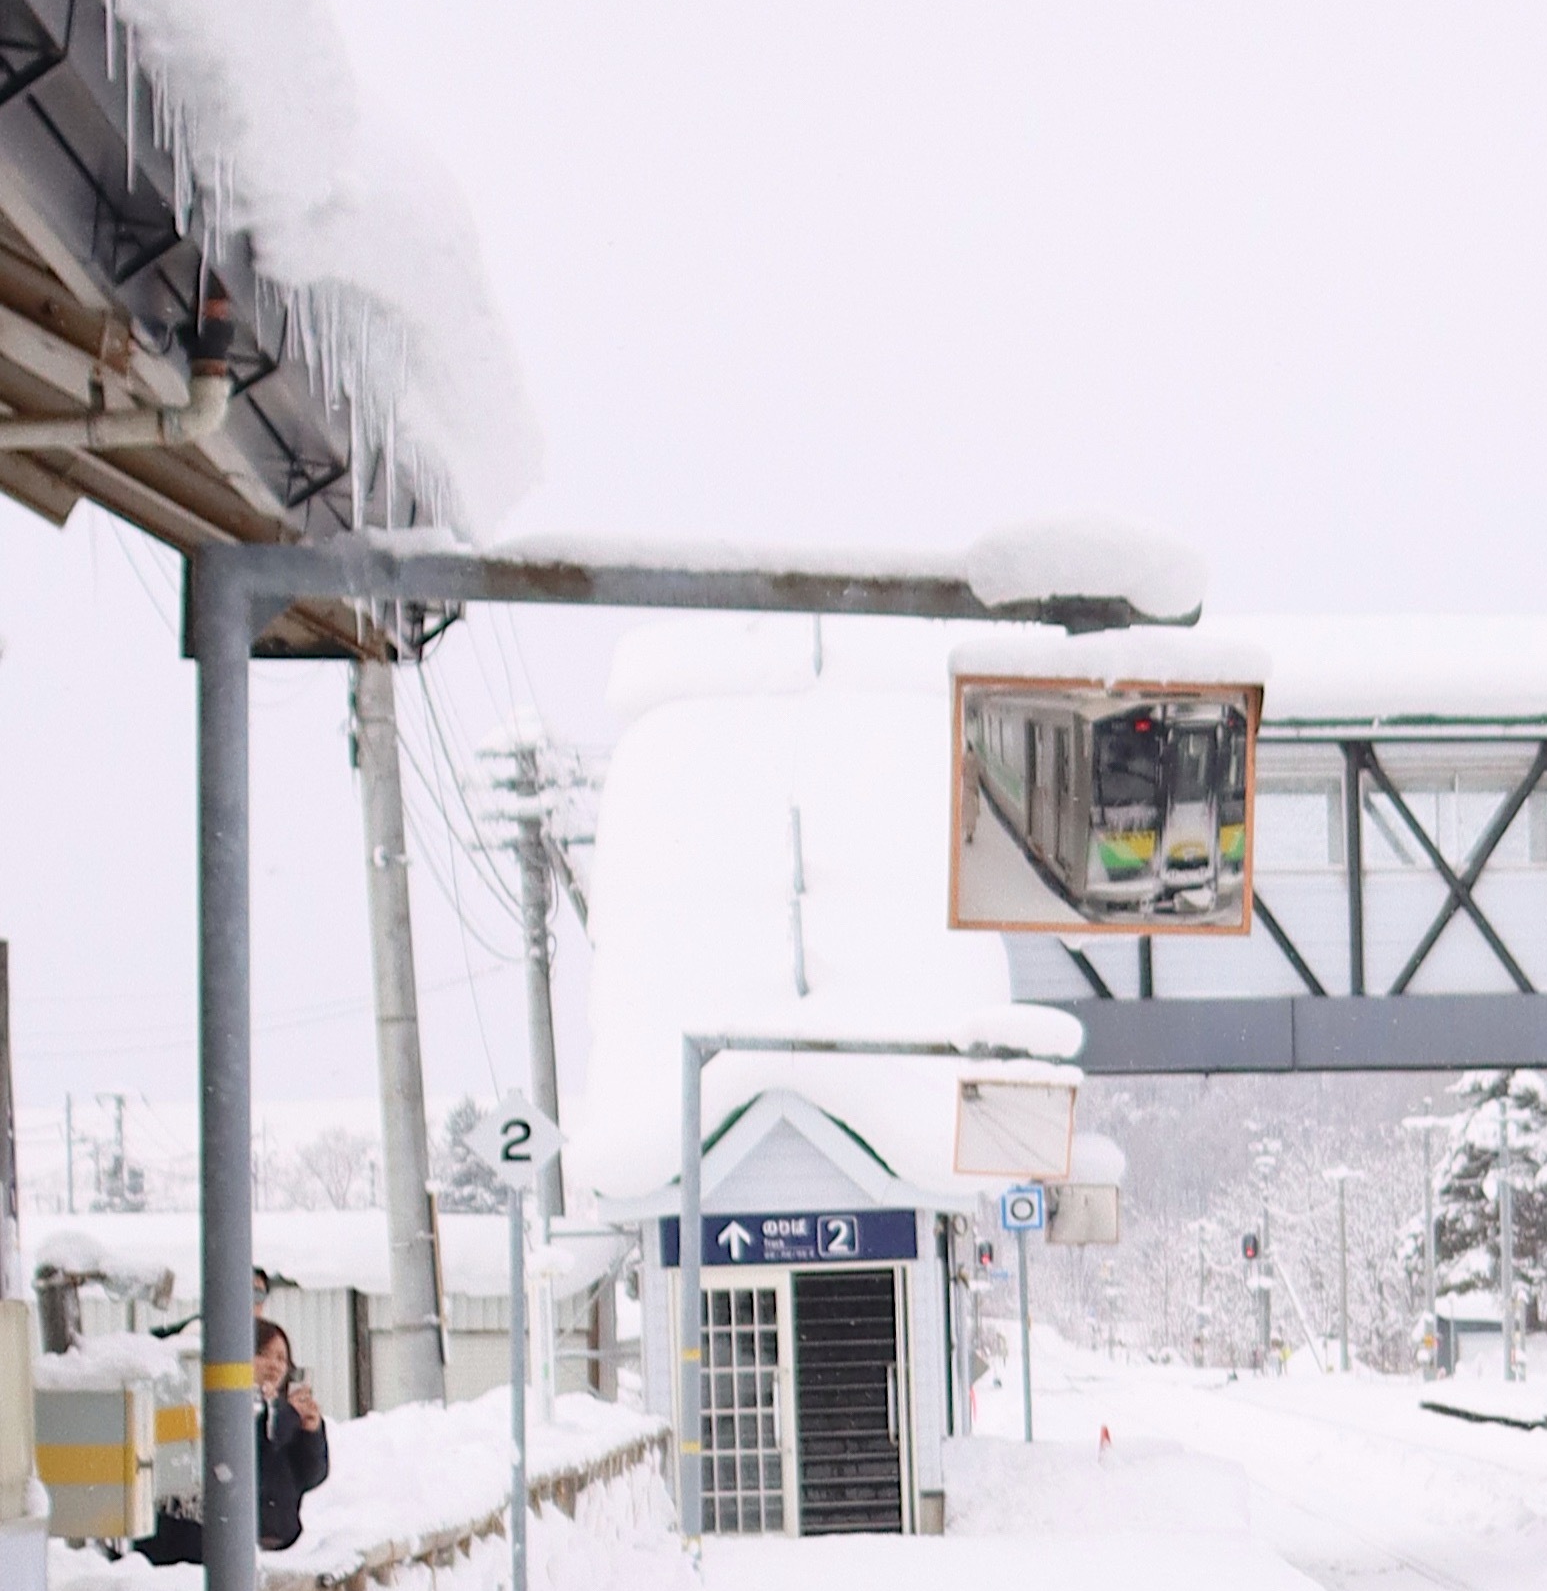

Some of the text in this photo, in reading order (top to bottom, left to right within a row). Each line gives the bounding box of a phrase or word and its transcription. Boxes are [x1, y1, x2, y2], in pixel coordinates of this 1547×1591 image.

[501, 1119, 532, 1161] 2
[762, 1218, 849, 1252] のりば 2
